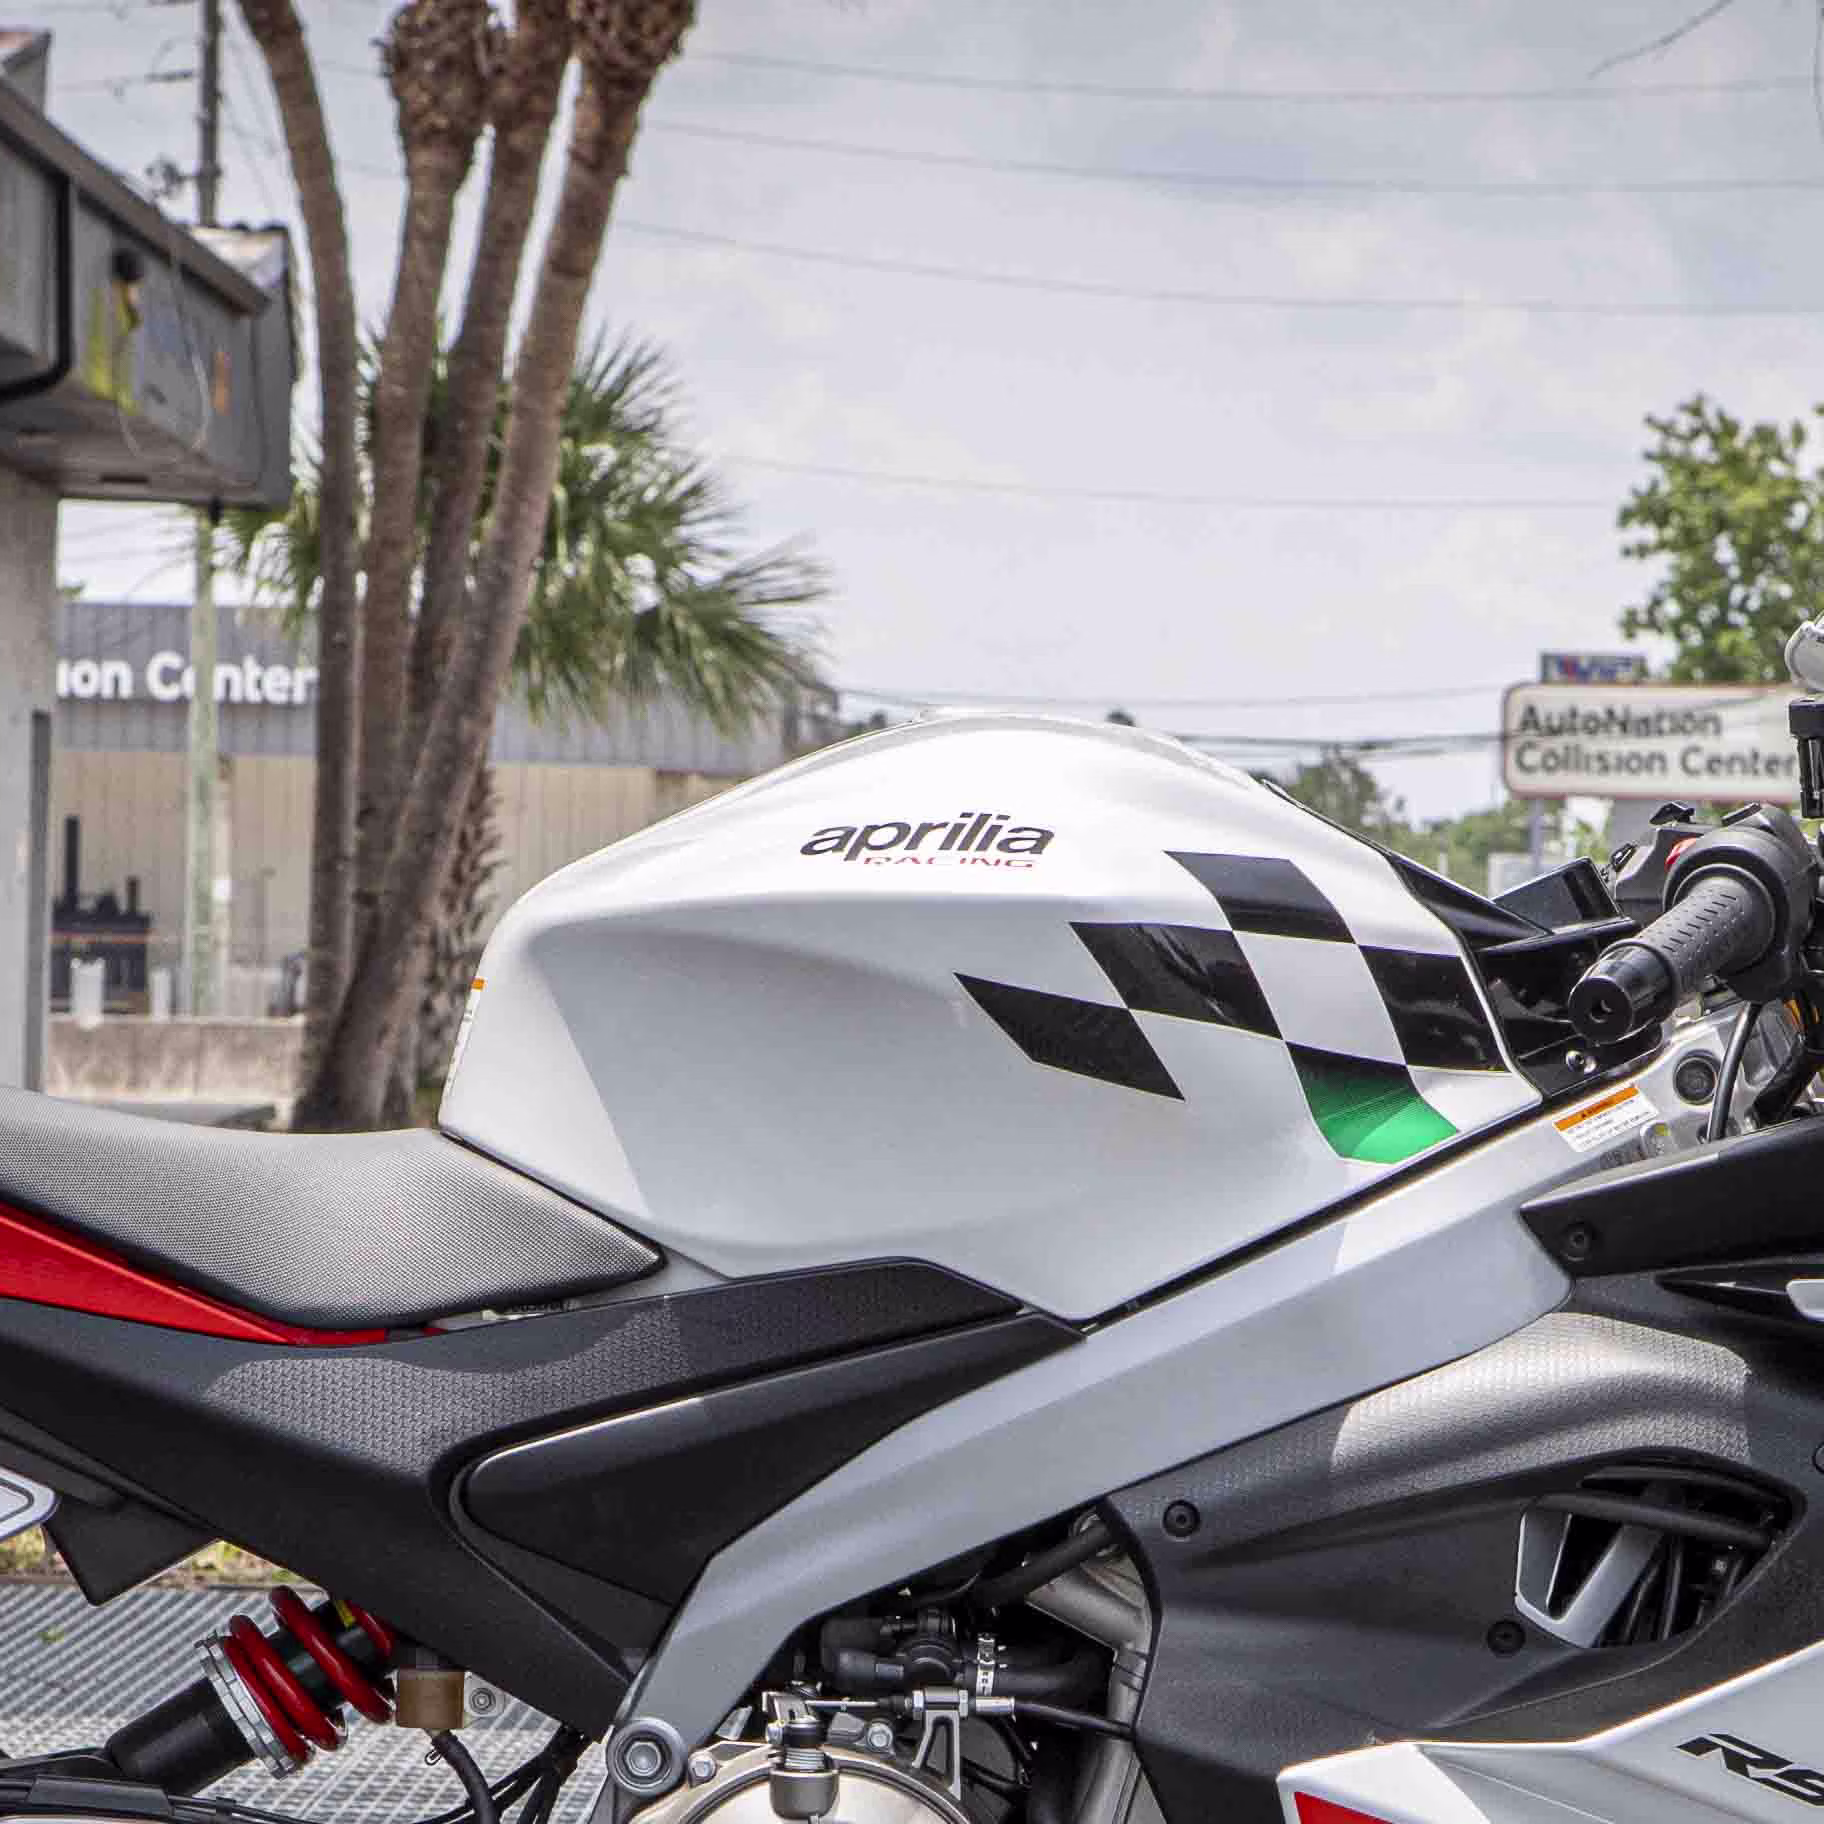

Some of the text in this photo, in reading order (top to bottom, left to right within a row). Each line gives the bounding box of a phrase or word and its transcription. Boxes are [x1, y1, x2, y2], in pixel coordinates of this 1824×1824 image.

[1519, 703, 1723, 738] AutoNation
[1516, 742, 1668, 775] Collision
[800, 812, 1055, 862] aprilia
